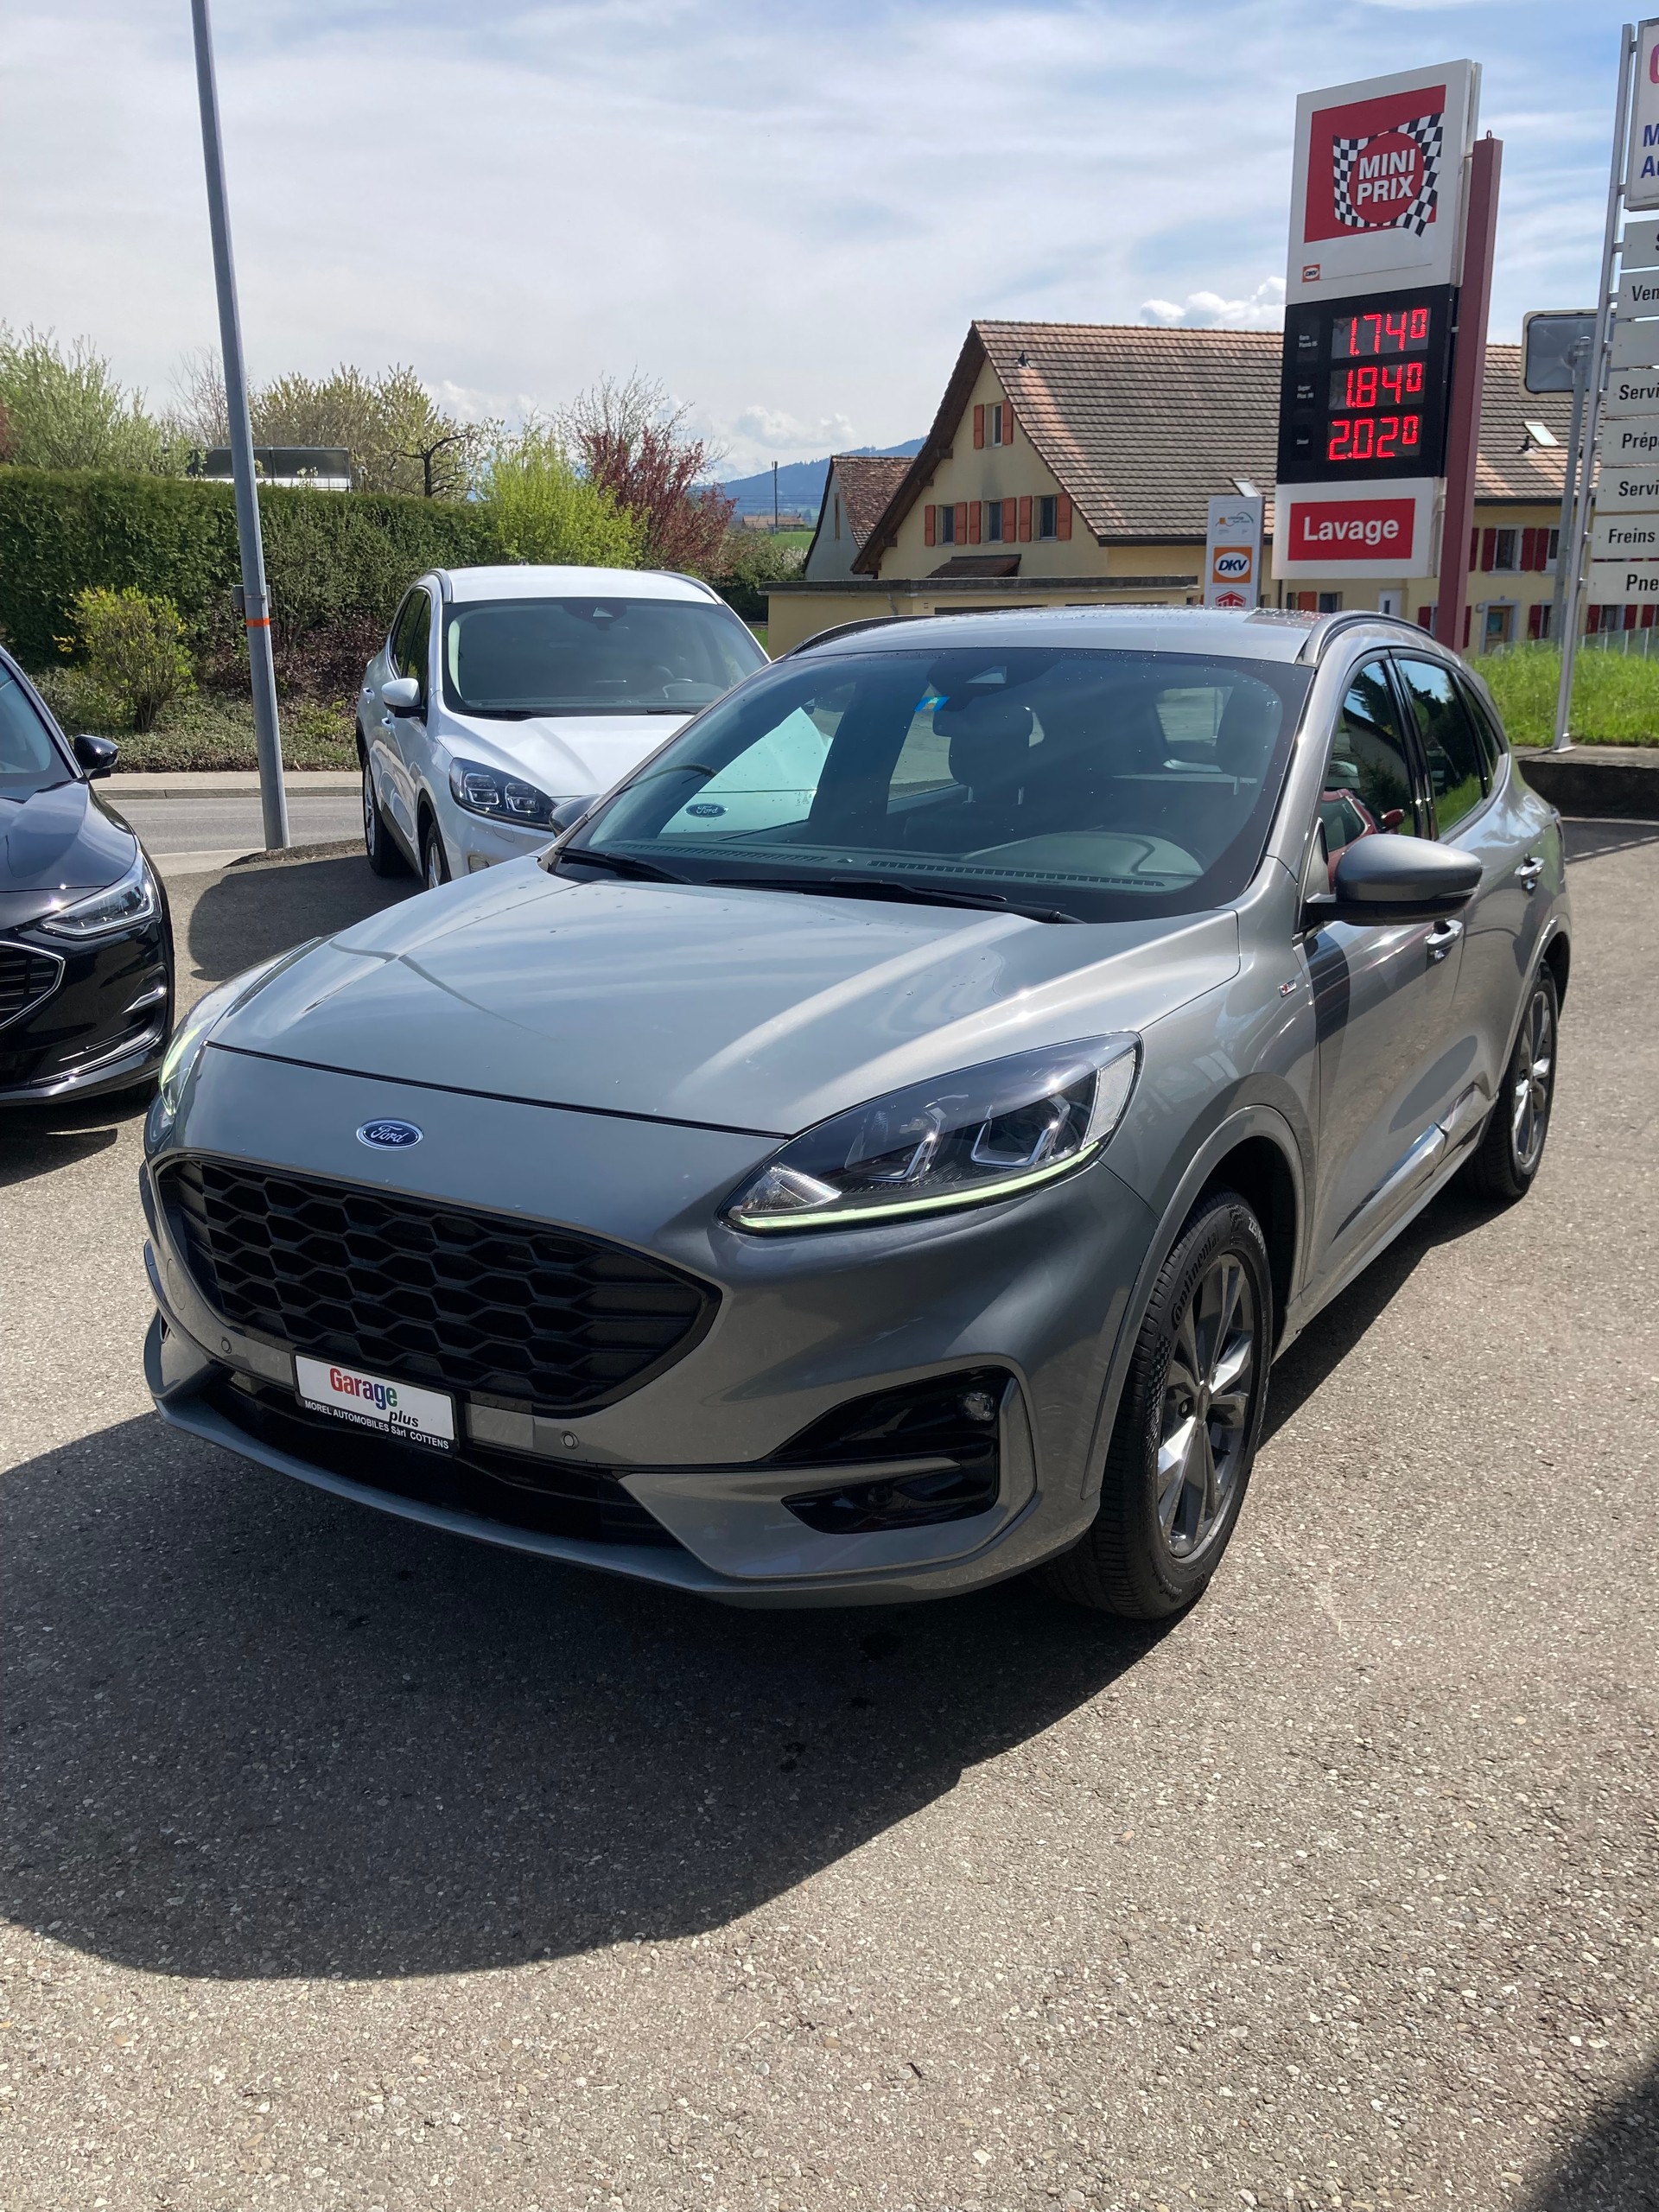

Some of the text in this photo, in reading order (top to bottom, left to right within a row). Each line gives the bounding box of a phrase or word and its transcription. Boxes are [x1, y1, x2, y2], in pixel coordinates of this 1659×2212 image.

[1358, 149, 1416, 180] MINI
[1357, 175, 1414, 206] PRIX
[1621, 432, 1659, 451] Prép
[1618, 479, 1659, 497] Servi
[1303, 517, 1399, 546] Lavage
[1608, 528, 1656, 544] Freins
[1217, 559, 1248, 571] DKV
[1625, 573, 1659, 592] Pne
[696, 805, 719, 814] Ford
[370, 1124, 410, 1143] Ford
[329, 1368, 397, 1411] Garage
[304, 1400, 333, 1415] MOREL
[333, 1408, 390, 1433] AUTOMOBILES
[410, 1431, 449, 1450] COTTENS
[389, 1410, 419, 1427] plus
